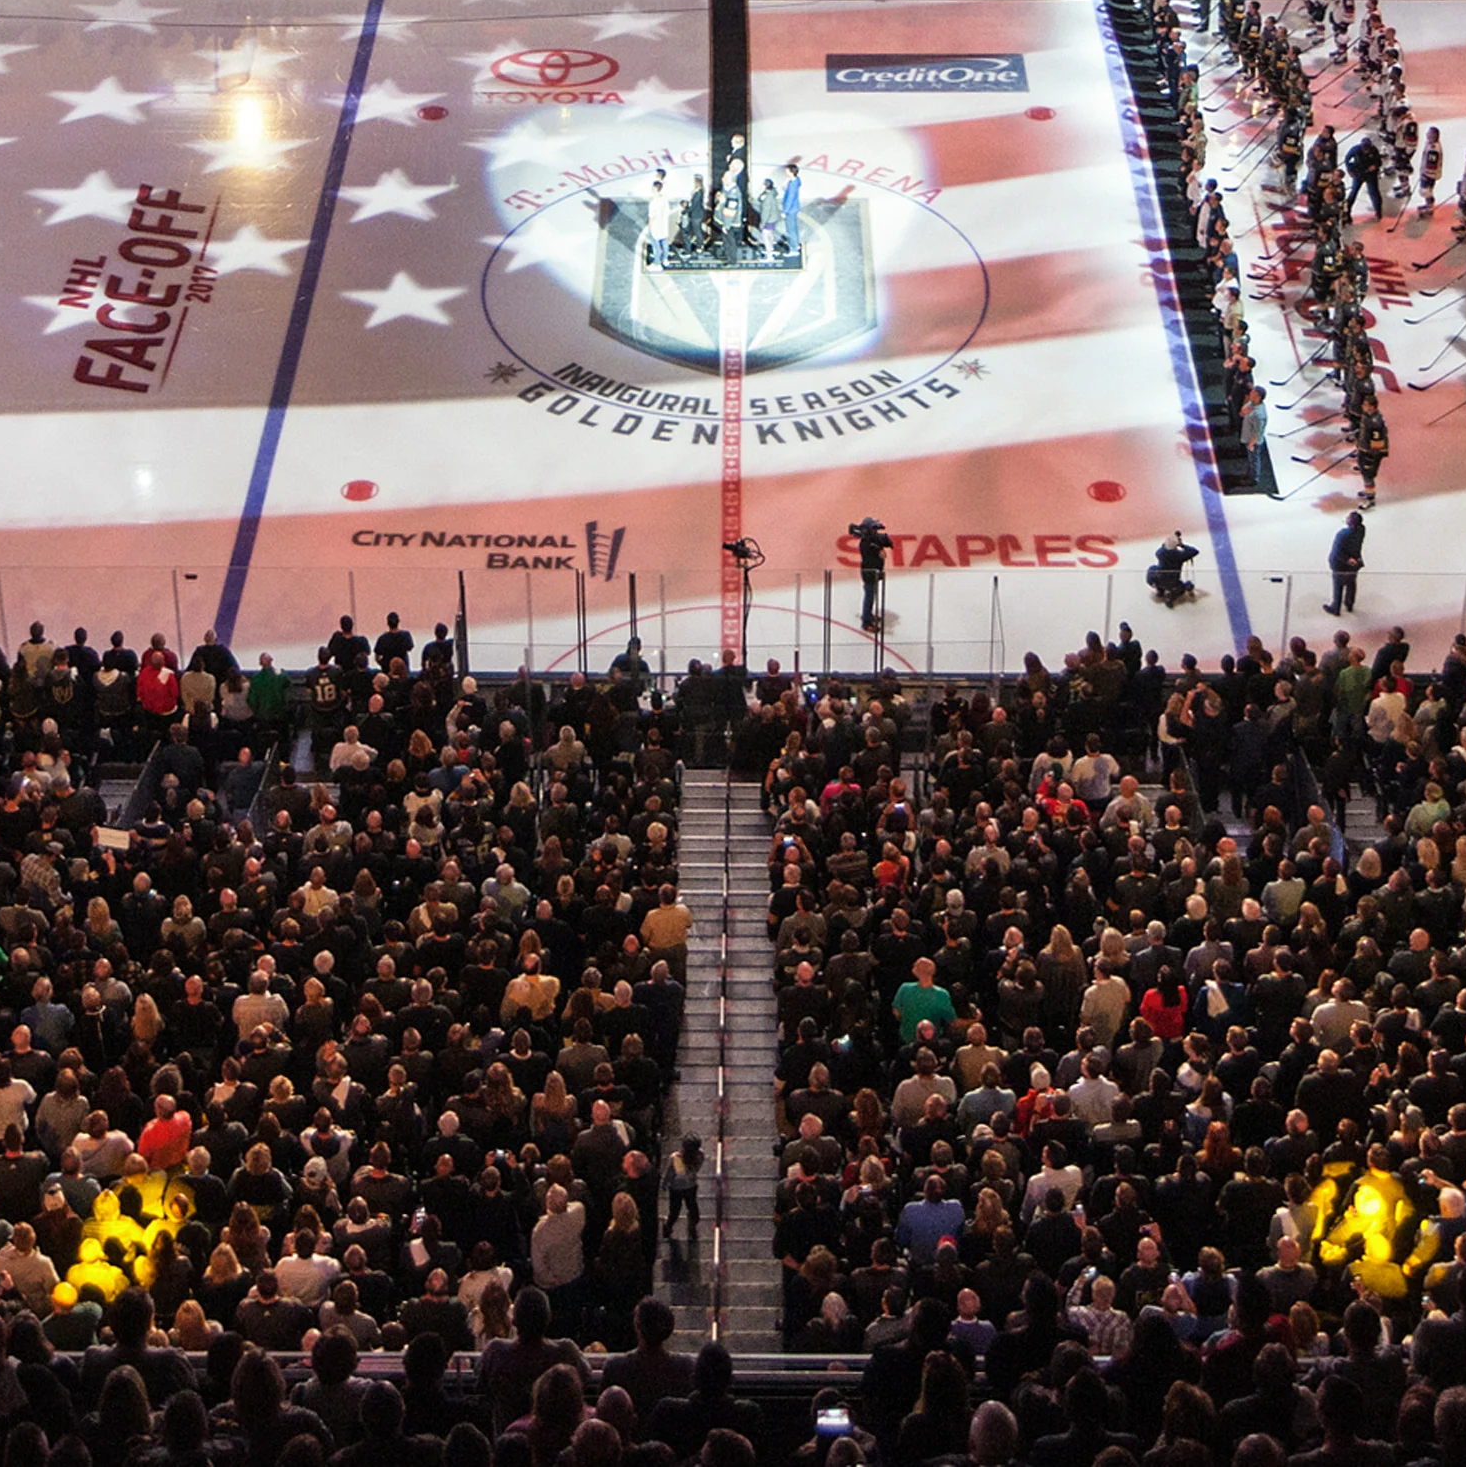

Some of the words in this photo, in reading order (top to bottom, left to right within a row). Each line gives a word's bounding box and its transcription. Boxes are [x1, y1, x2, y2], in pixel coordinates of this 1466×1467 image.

[483, 91, 625, 105] TOYOTA
[808, 152, 943, 206] ARENA
[58, 254, 107, 309] NHL
[72, 183, 206, 394] FACE-OFF
[185, 265, 219, 305] 2017
[516, 380, 723, 446] GOLDEN
[755, 377, 961, 446] KNIGHTS
[552, 361, 719, 416] INAUGURAL
[749, 368, 903, 416] SEASON
[351, 530, 417, 547] CITY
[420, 530, 577, 548] NATIONAL
[486, 552, 575, 570] BANK
[315, 684, 336, 702] 18
